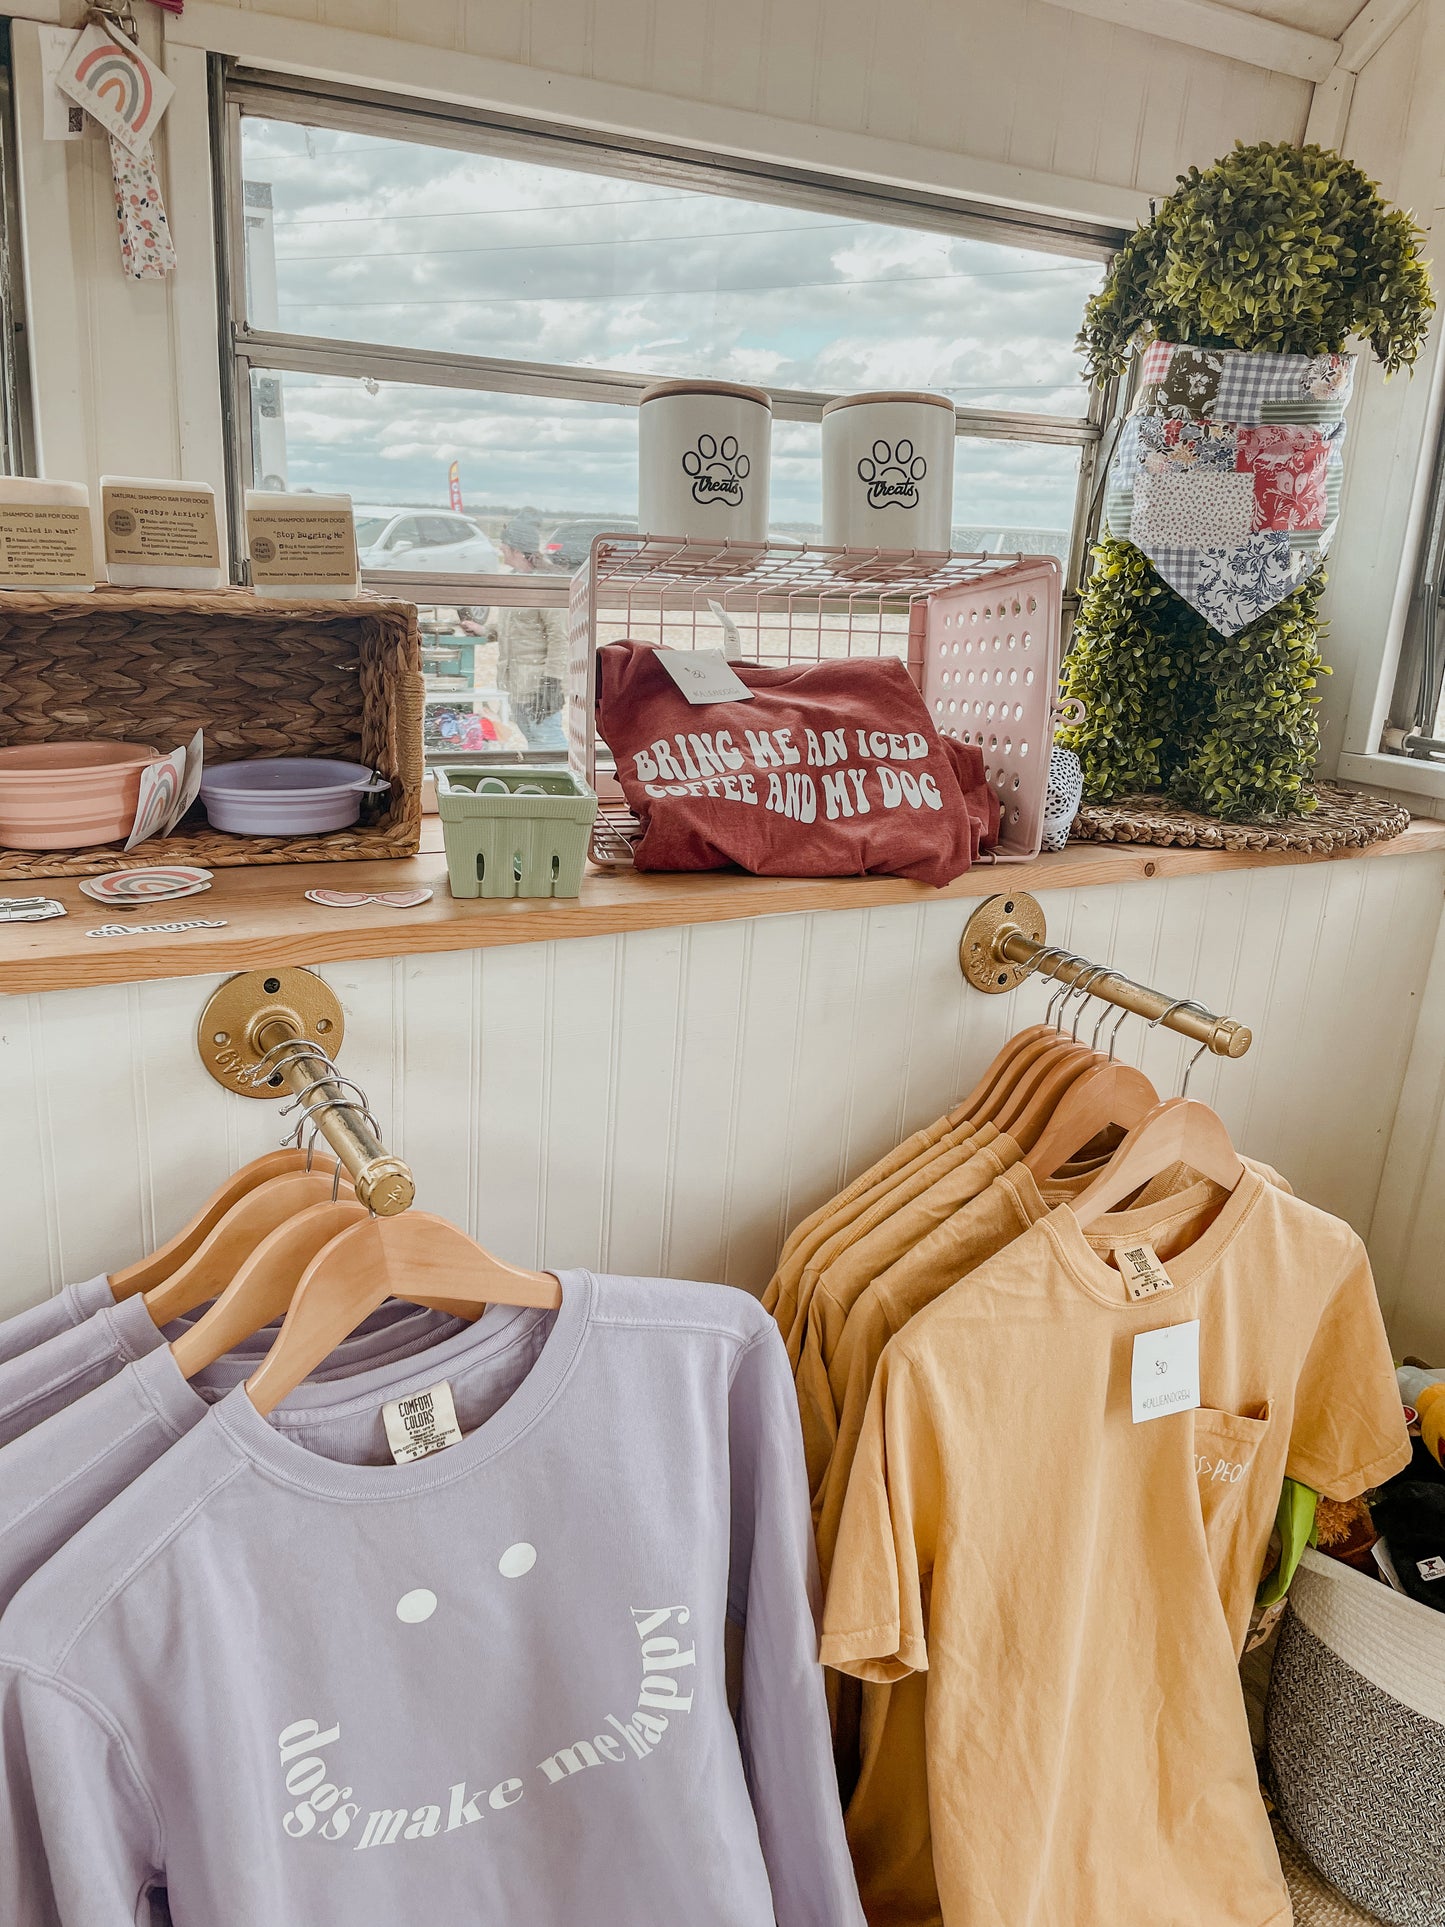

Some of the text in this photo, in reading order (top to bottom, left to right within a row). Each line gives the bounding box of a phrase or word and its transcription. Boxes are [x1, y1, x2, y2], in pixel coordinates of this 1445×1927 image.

[694, 474, 740, 494] Treats
[869, 477, 914, 497] Treats
[632, 728, 929, 782] BRING ME AN ICED
[644, 766, 944, 824] COFFEE AND MY DOG
[398, 1392, 434, 1418] COMFORT
[404, 1408, 435, 1431] COLORS
[278, 1604, 696, 1850] dogs make me happy
